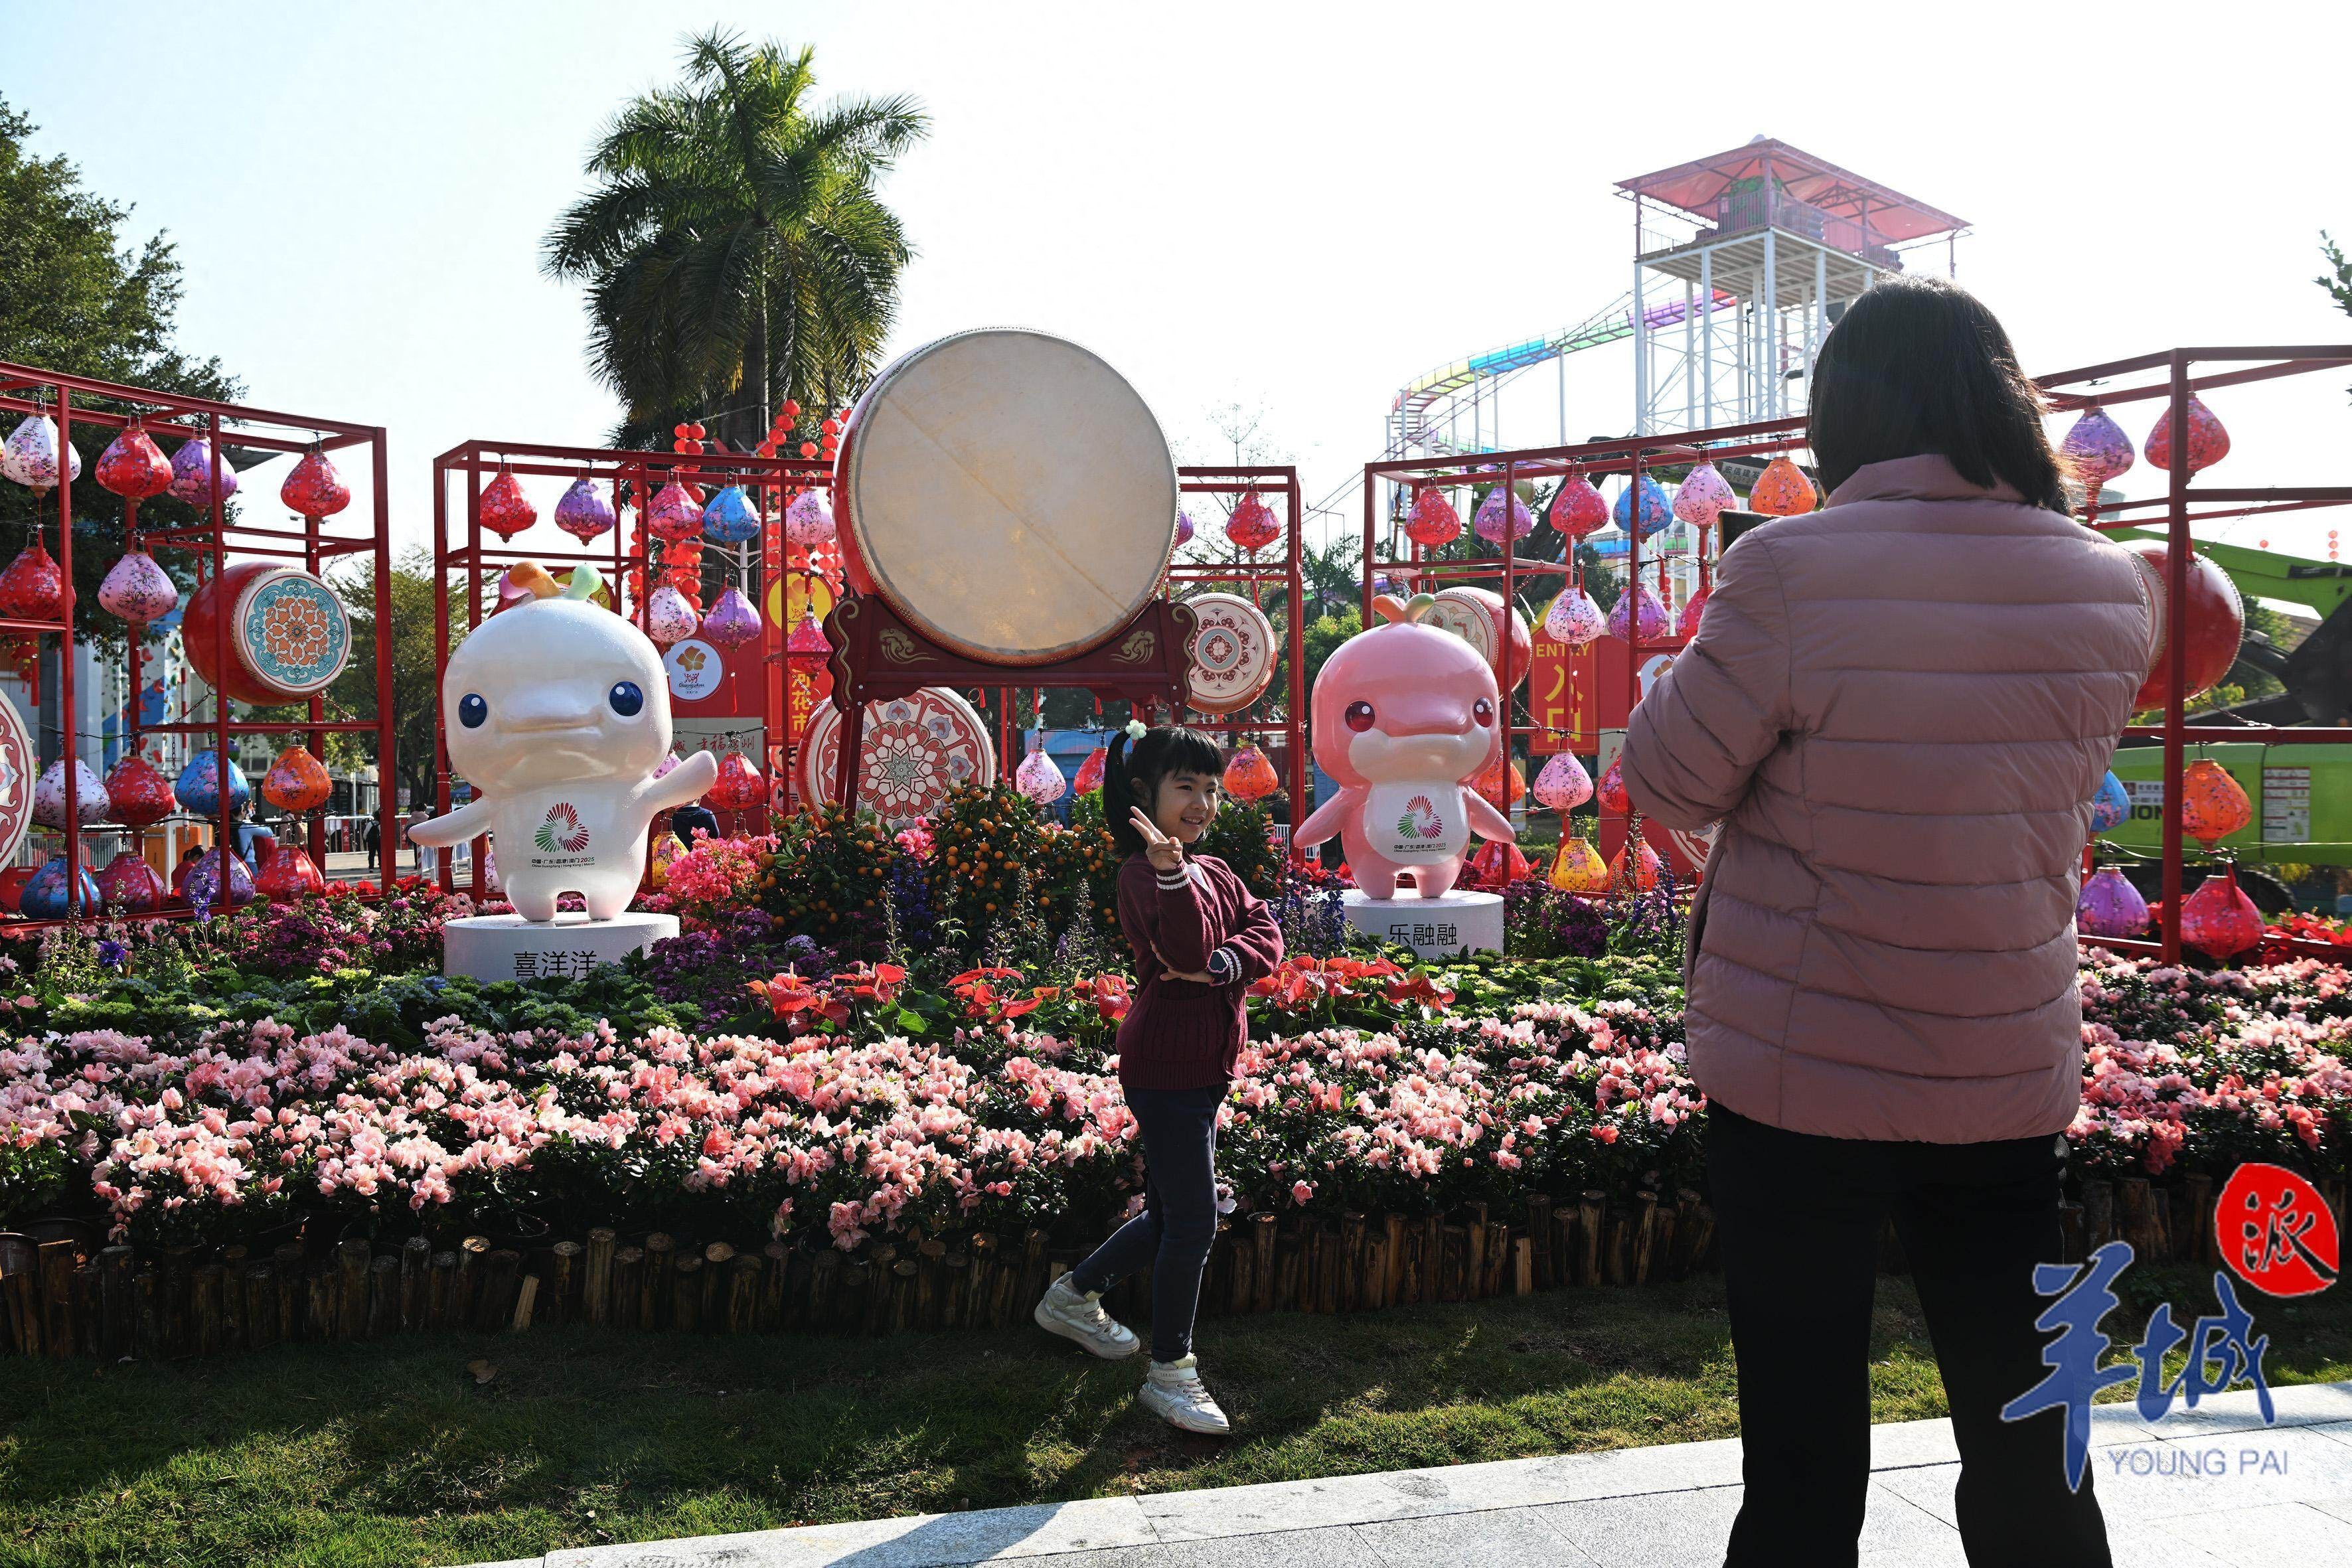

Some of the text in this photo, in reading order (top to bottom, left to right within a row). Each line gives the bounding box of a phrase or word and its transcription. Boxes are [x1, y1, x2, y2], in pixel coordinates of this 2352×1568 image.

[1544, 664, 1583, 742] 入口
[1389, 923, 1457, 946] 乐融融
[513, 950, 597, 977] 喜洋洋
